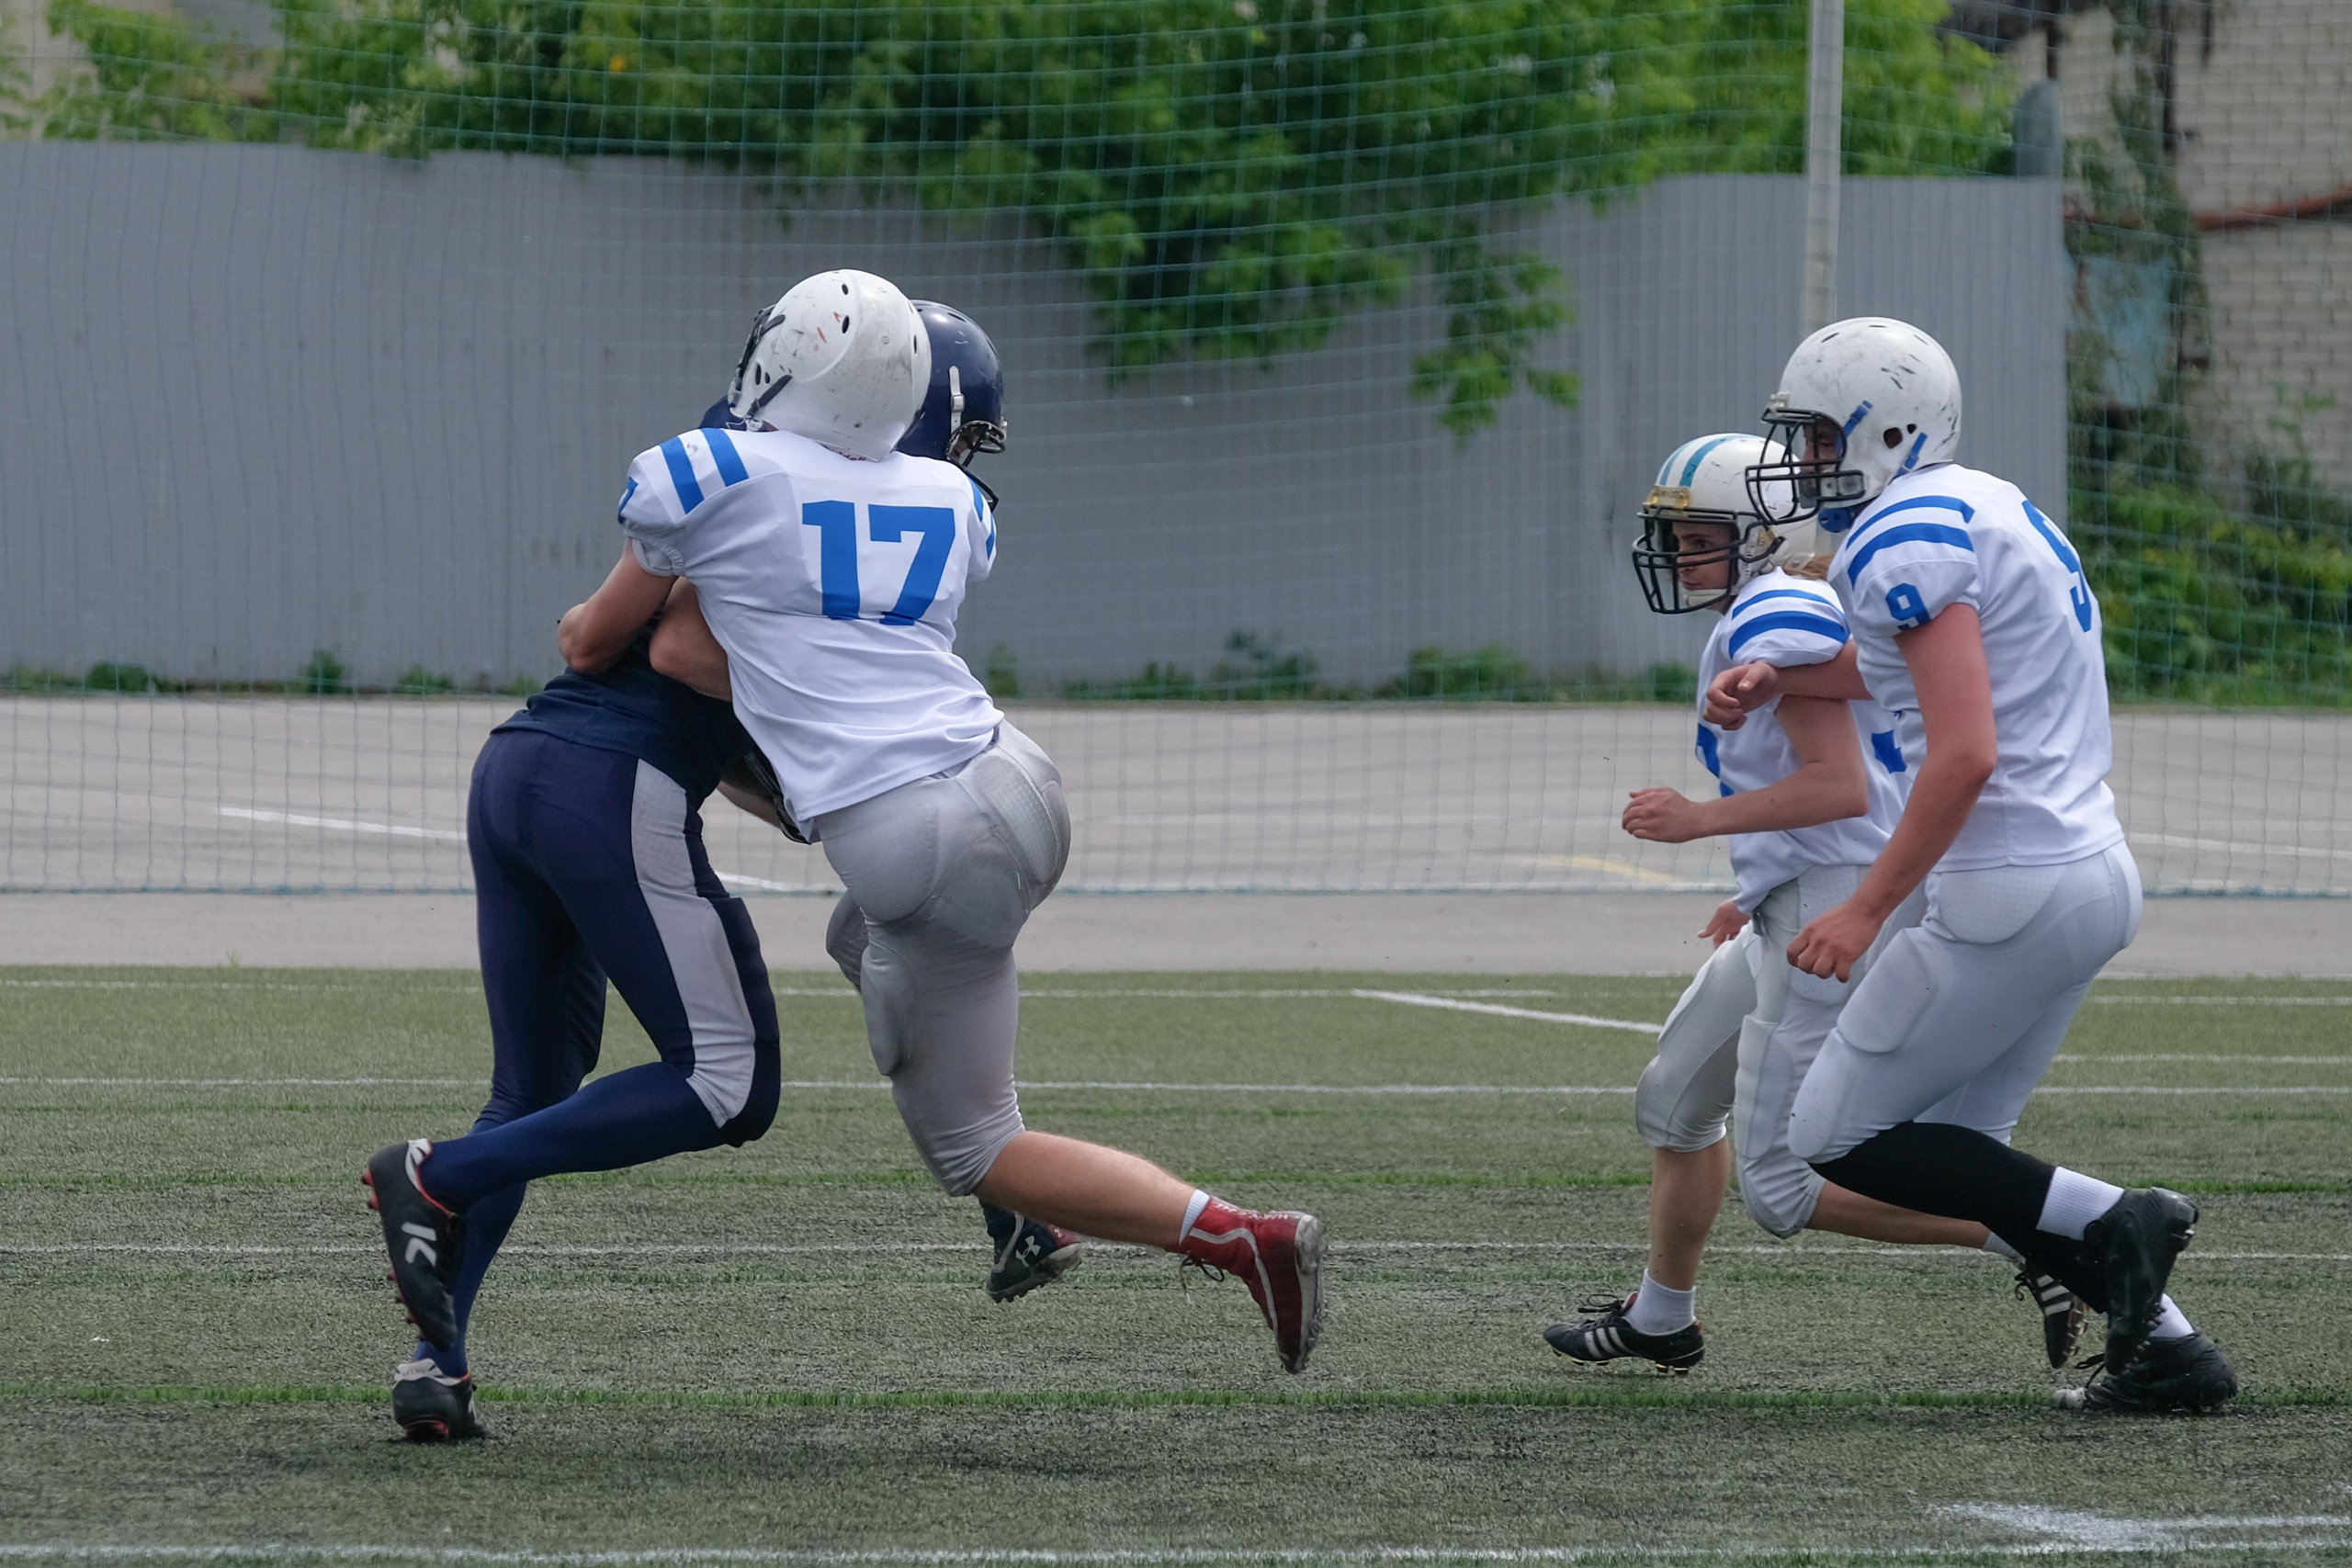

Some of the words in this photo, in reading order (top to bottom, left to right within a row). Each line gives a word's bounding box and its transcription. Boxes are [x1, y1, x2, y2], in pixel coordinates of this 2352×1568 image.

[801, 500, 956, 626] 17
[1885, 582, 1931, 631] 9
[2021, 500, 2092, 633] 9
